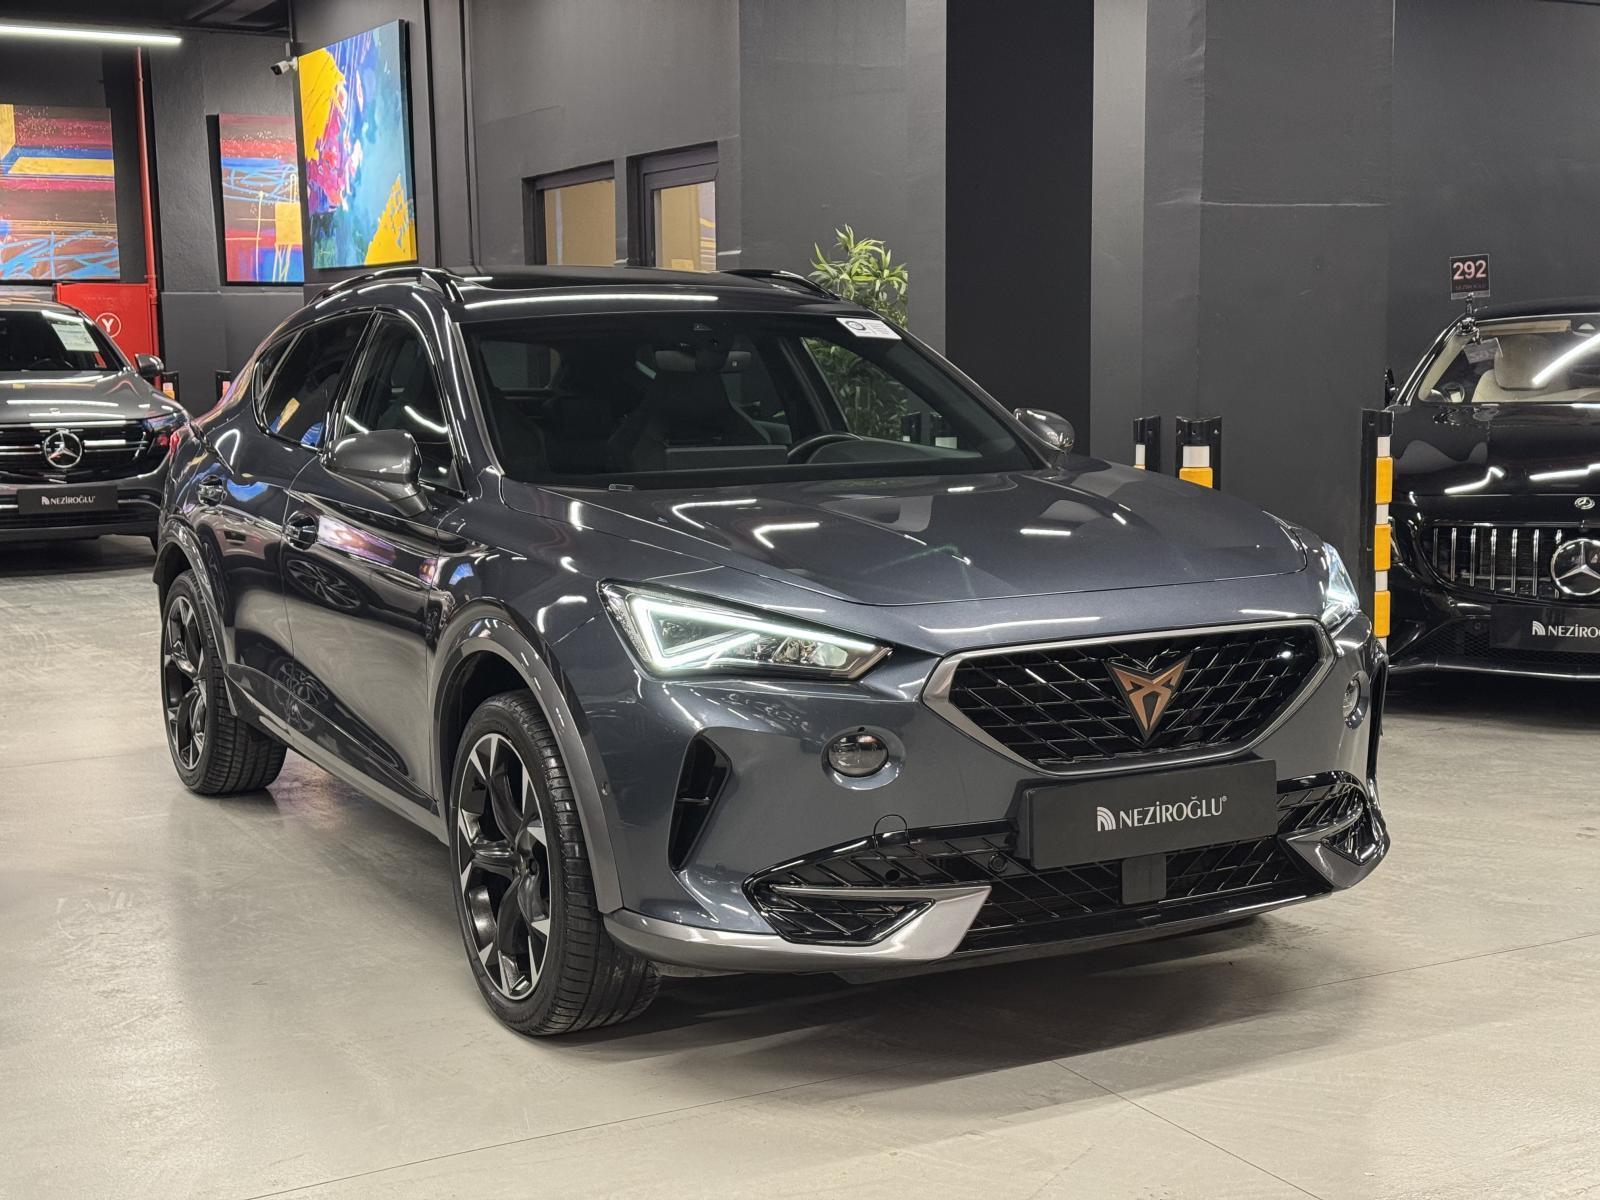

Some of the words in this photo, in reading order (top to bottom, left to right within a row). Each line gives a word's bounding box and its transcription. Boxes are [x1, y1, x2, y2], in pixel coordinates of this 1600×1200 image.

[1453, 260, 1487, 280] 292
[101, 318, 115, 333] Y
[1547, 623, 1600, 638] NEZİRO
